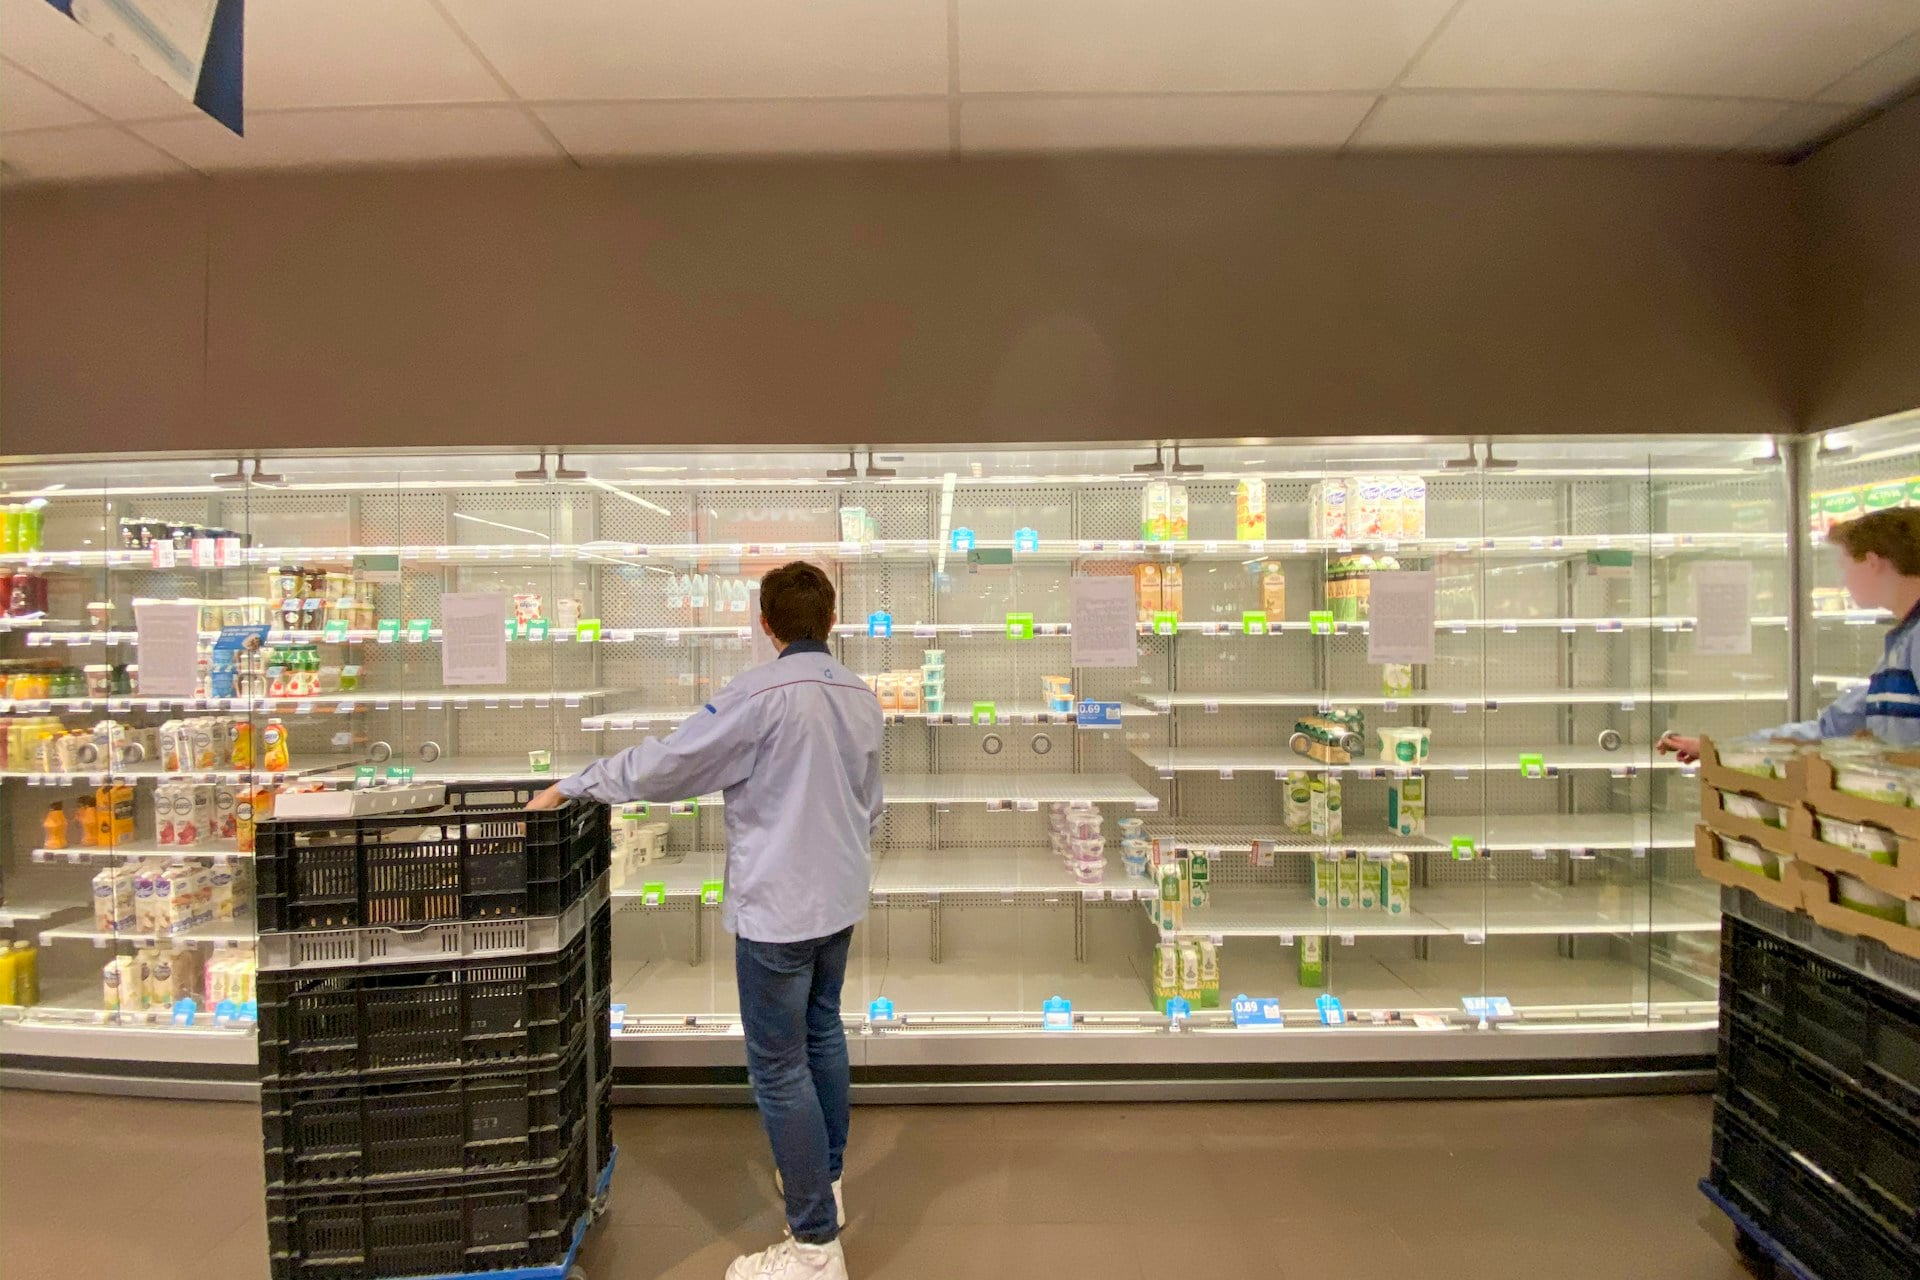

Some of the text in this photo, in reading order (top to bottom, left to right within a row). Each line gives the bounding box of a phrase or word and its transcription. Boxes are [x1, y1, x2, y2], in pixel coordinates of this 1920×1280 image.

[1079, 704, 1101, 714] 0.69
[1181, 990, 1201, 999] VAN
[1235, 1001, 1258, 1012] 0.89
